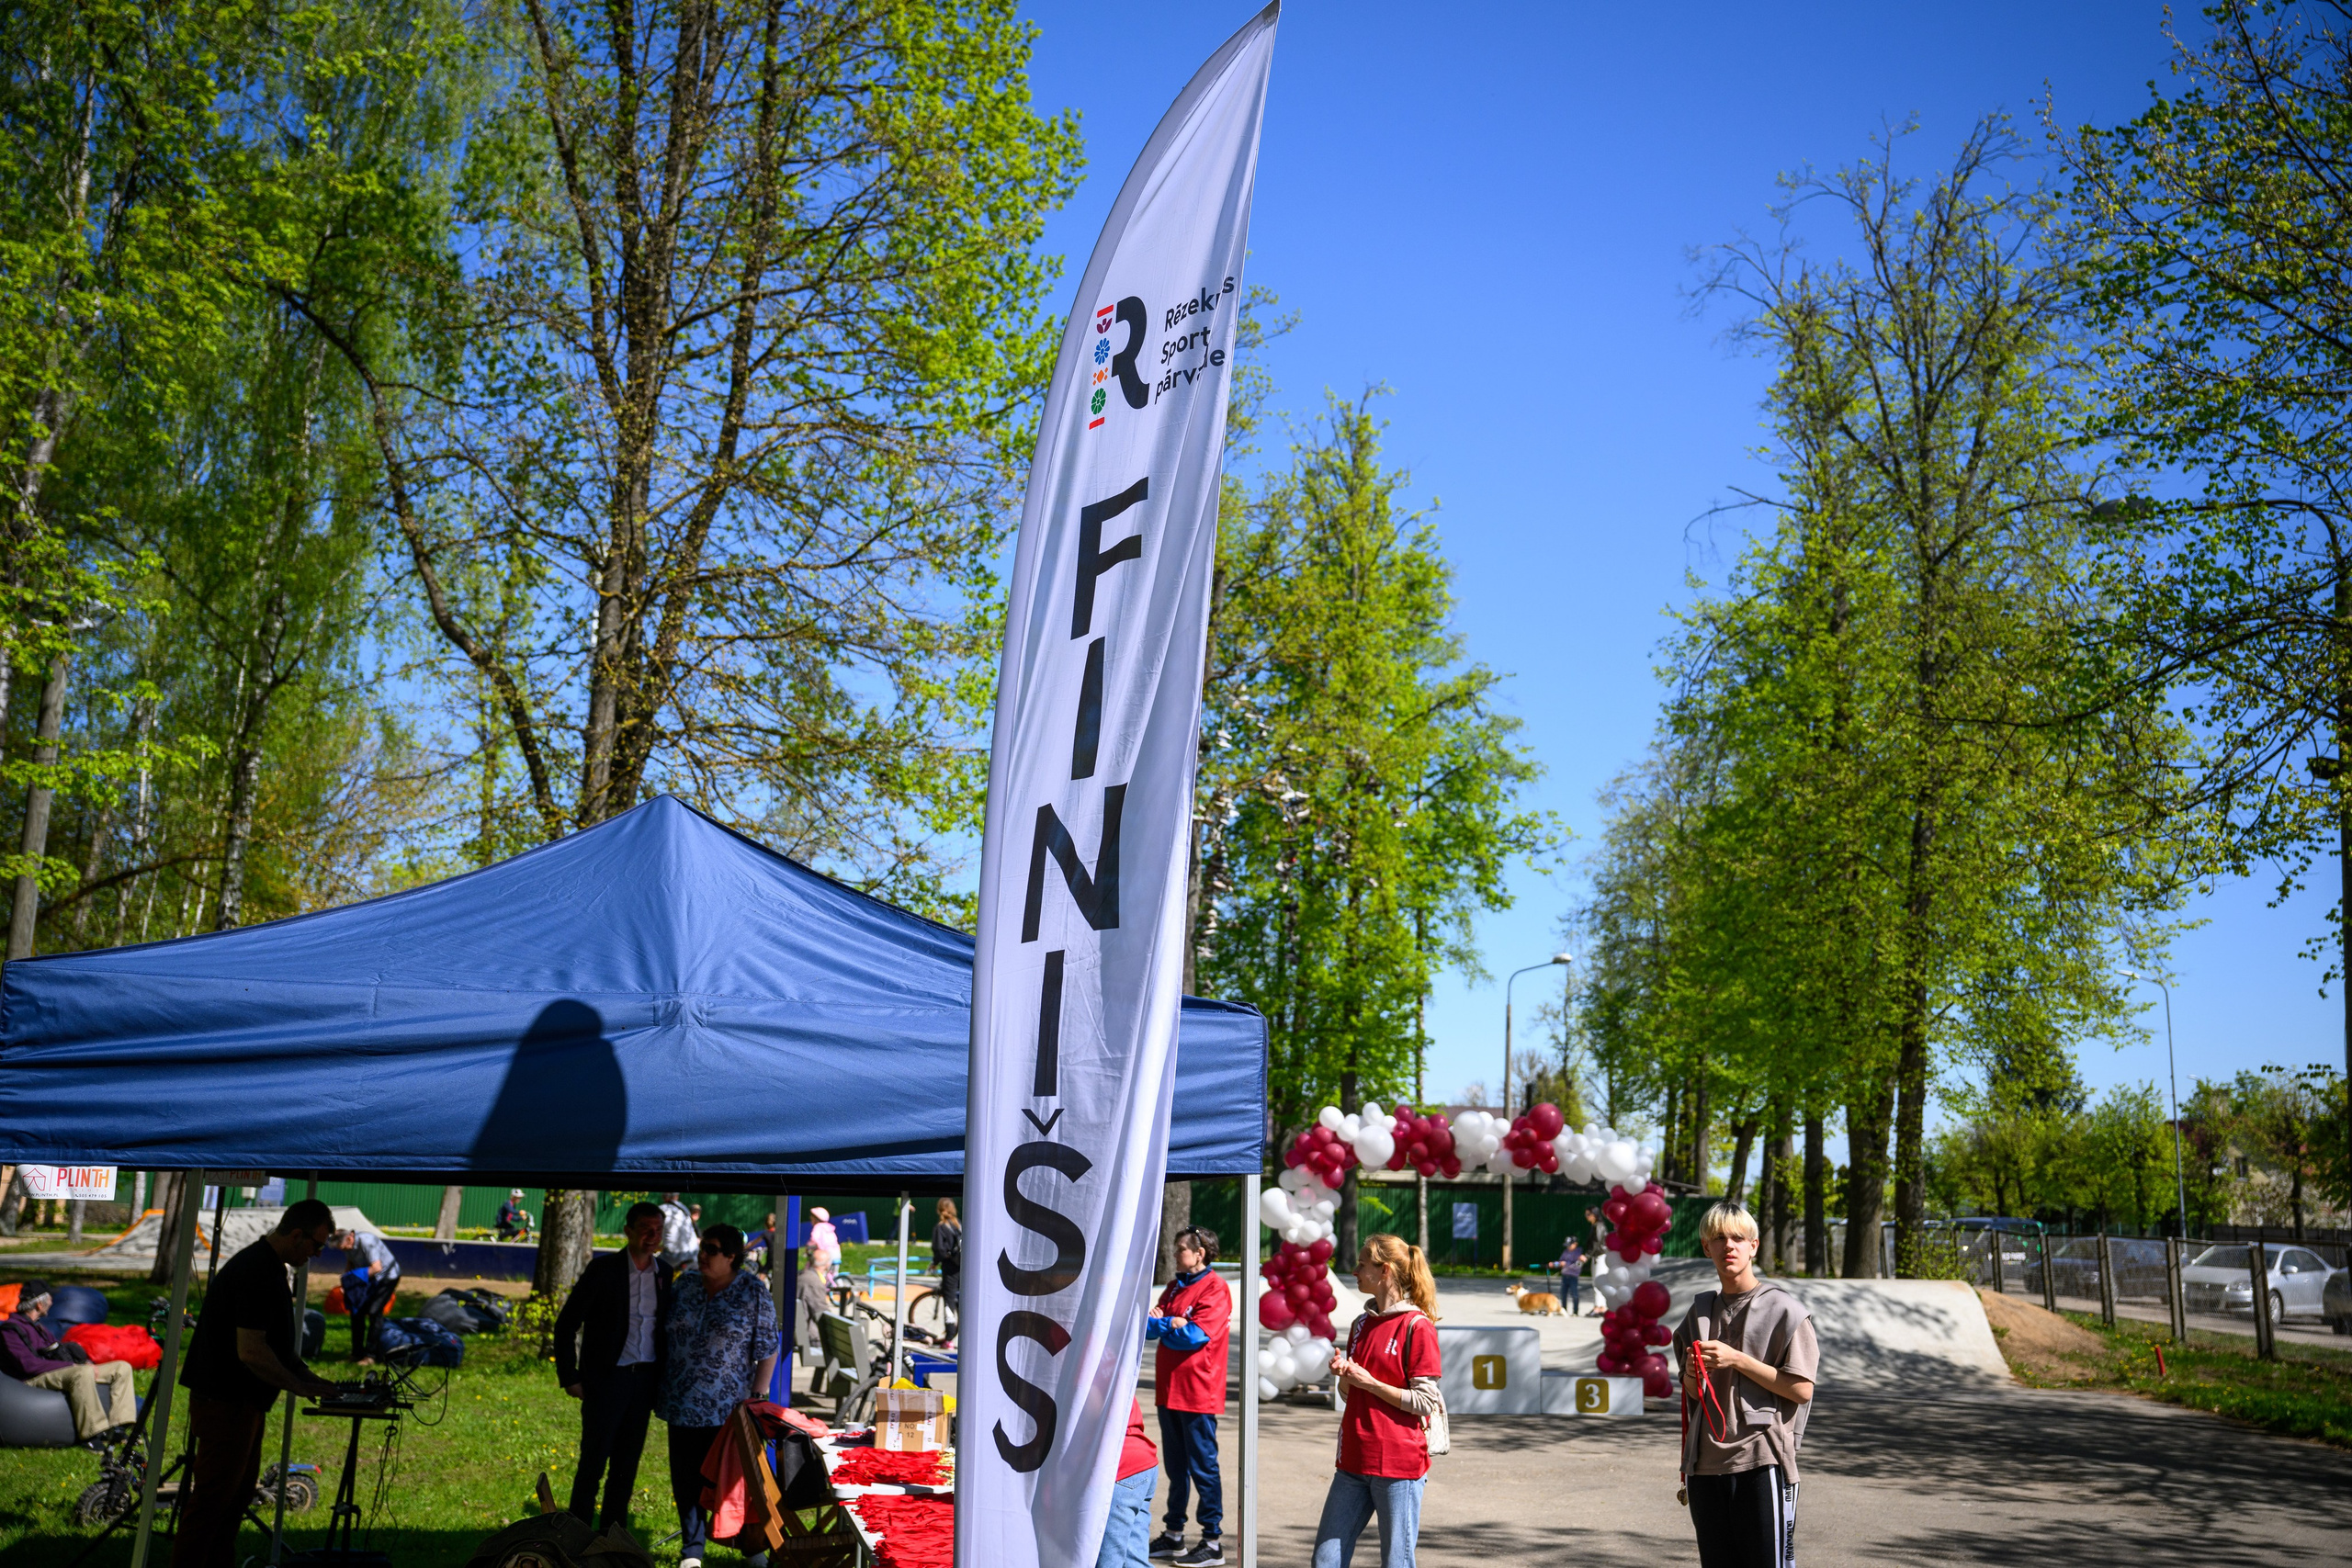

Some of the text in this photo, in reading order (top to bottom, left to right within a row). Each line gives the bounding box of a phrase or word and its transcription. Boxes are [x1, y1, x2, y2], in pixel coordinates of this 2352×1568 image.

[1164, 276, 1235, 332] Rēzeks
[1160, 326, 1212, 366] Sport
[992, 476, 1149, 1473] FINIŠS
[56, 1168, 109, 1188] PLINTH
[1482, 1360, 1494, 1384] 1
[1584, 1383, 1601, 1408] 3
